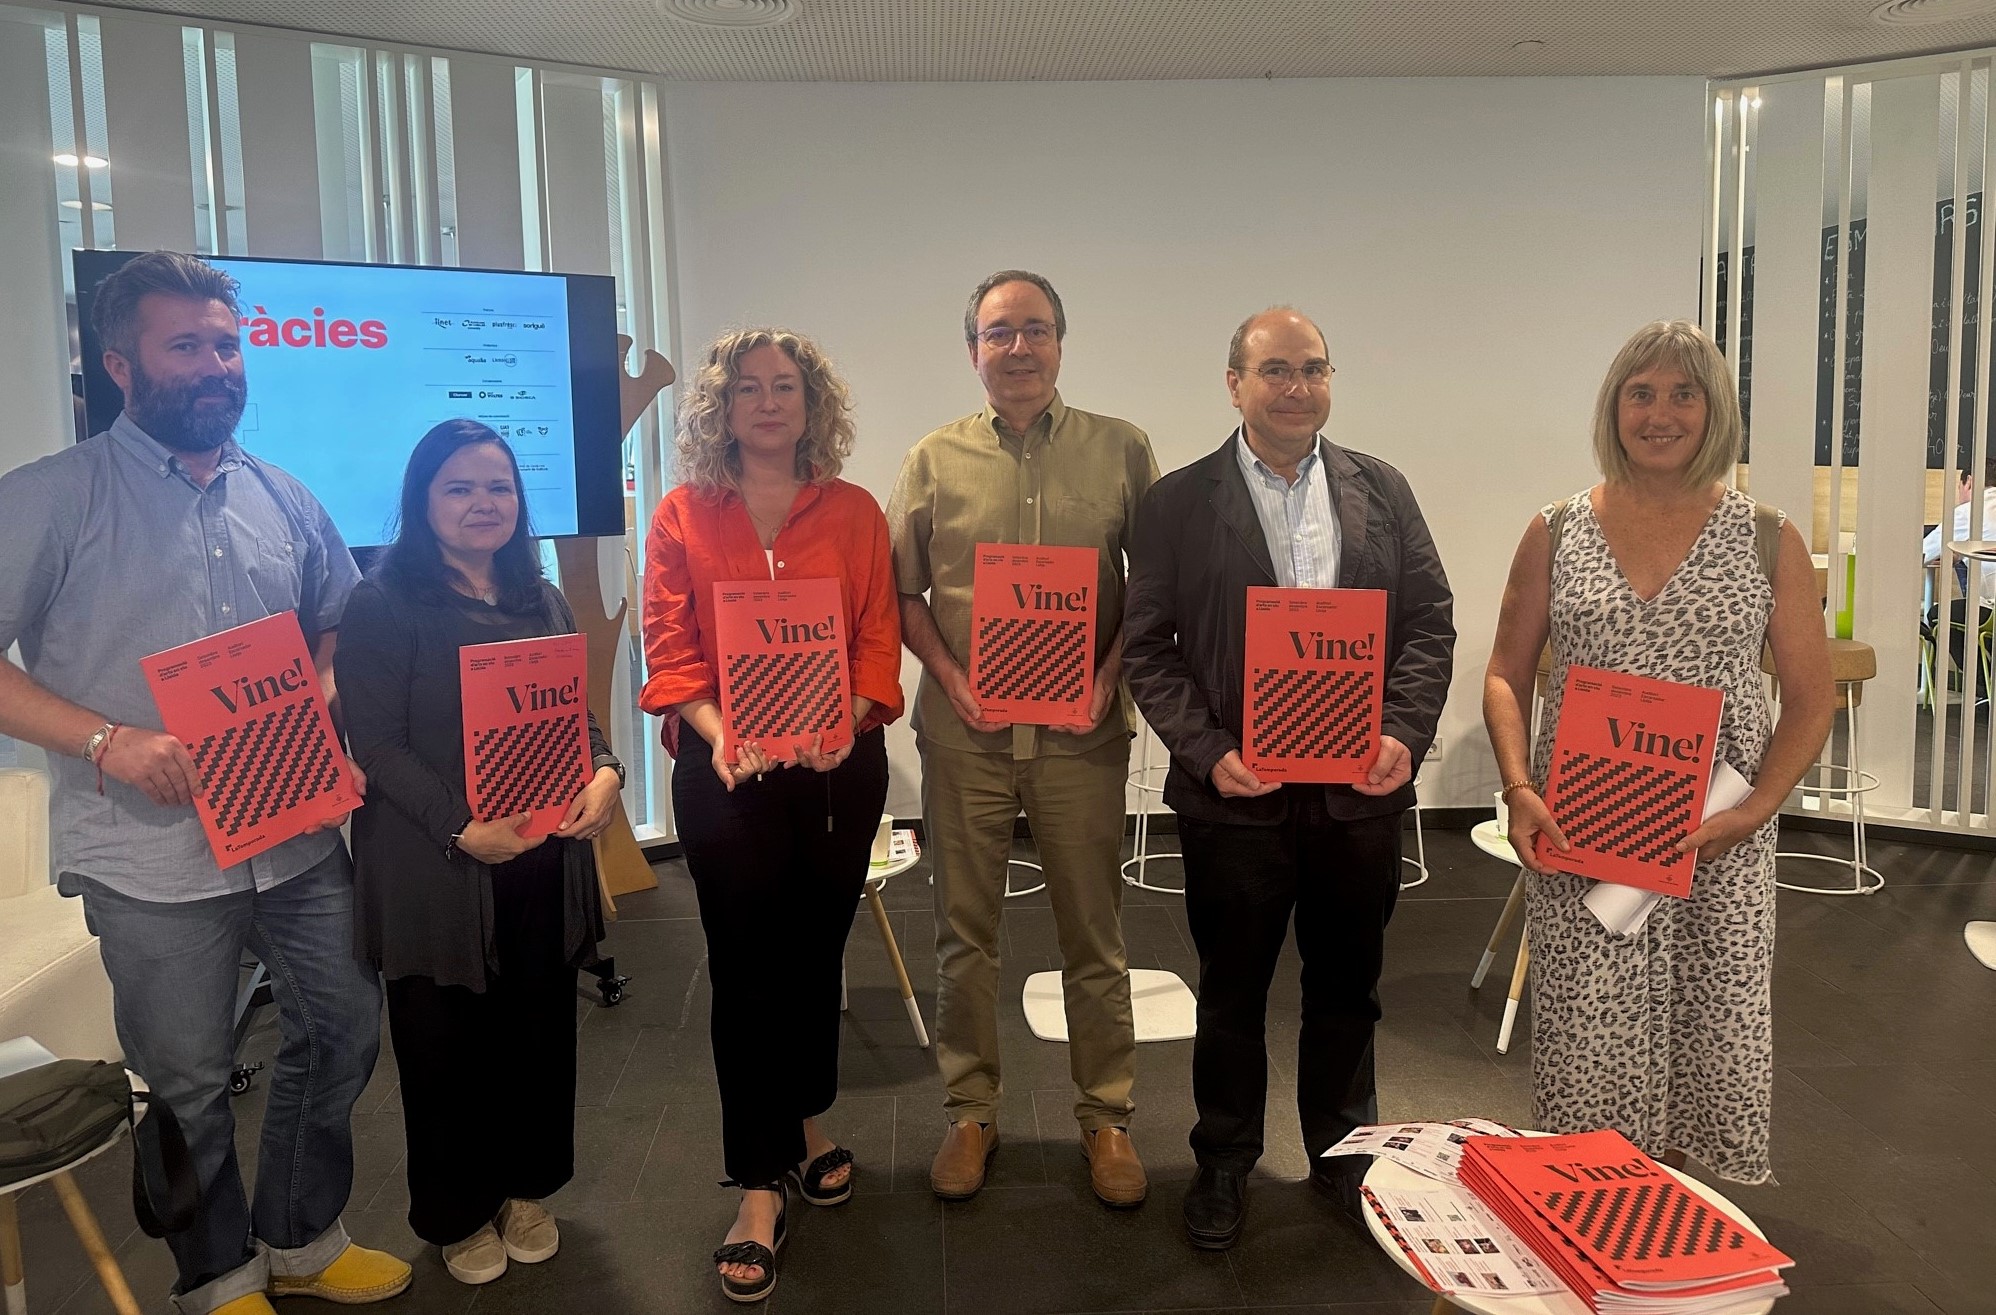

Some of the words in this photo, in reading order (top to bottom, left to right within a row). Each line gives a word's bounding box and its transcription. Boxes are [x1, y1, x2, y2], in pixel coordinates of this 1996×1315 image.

[240, 305, 388, 349] àcies
[1011, 583, 1088, 612] Vine!
[755, 615, 836, 644] Vine!
[1288, 631, 1375, 661] Vine!
[209, 657, 309, 714] Vine!
[506, 676, 579, 714] Vine!
[1606, 716, 1705, 764] Vine!
[231, 834, 266, 853] LaTemporada
[1542, 1158, 1659, 1183] Vine!
